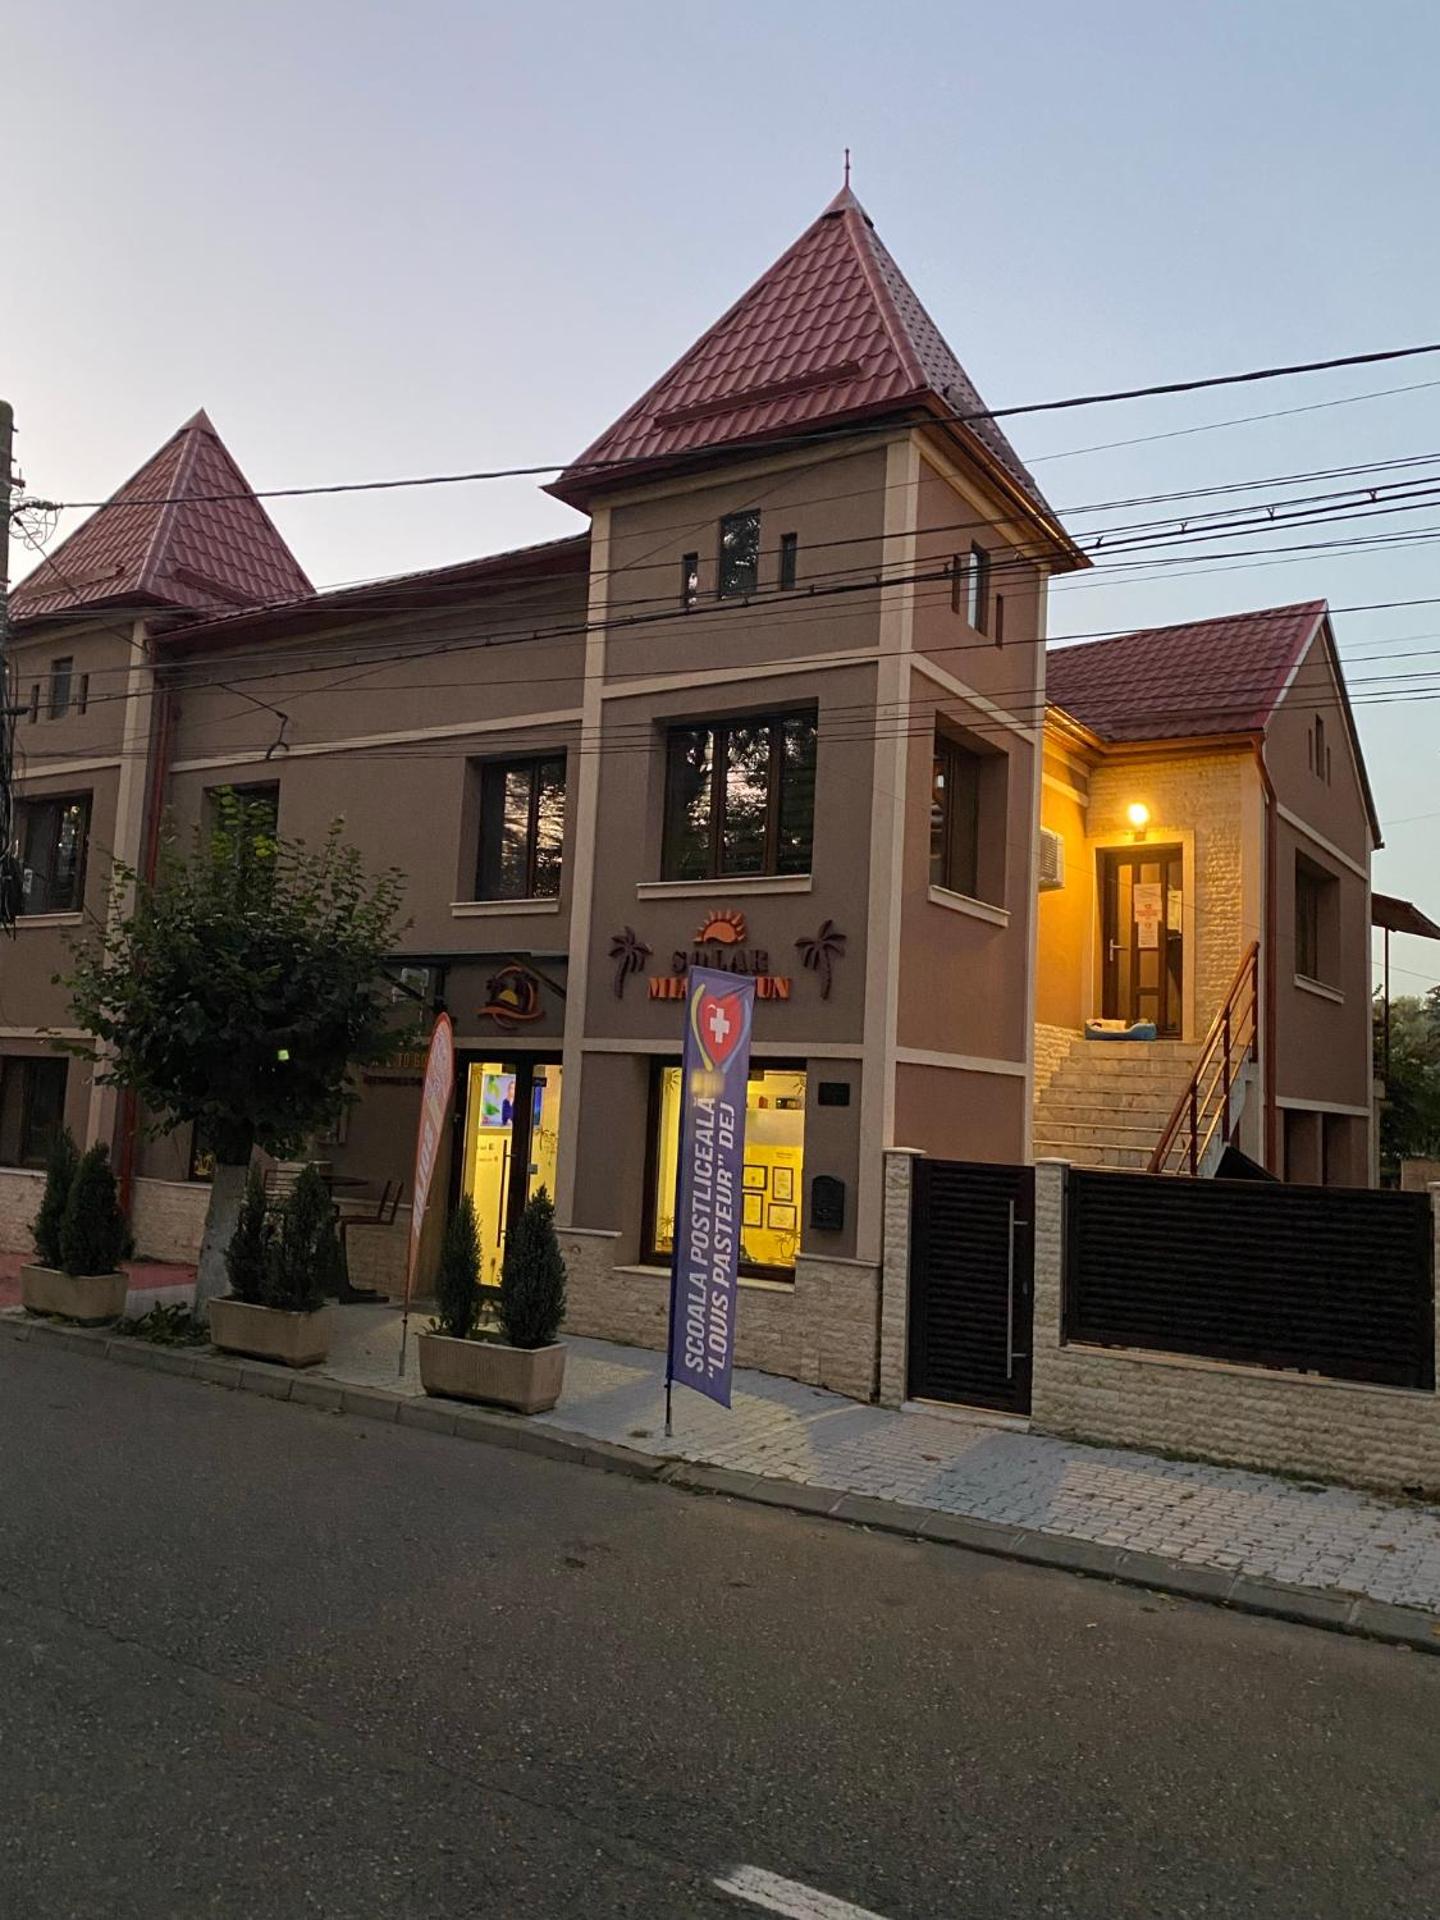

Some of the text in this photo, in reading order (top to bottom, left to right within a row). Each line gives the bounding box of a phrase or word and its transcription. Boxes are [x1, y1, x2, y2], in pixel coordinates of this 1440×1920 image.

[672, 950, 769, 974] SOLAR
[756, 976, 791, 999] UN
[718, 1101, 735, 1150] DEJ
